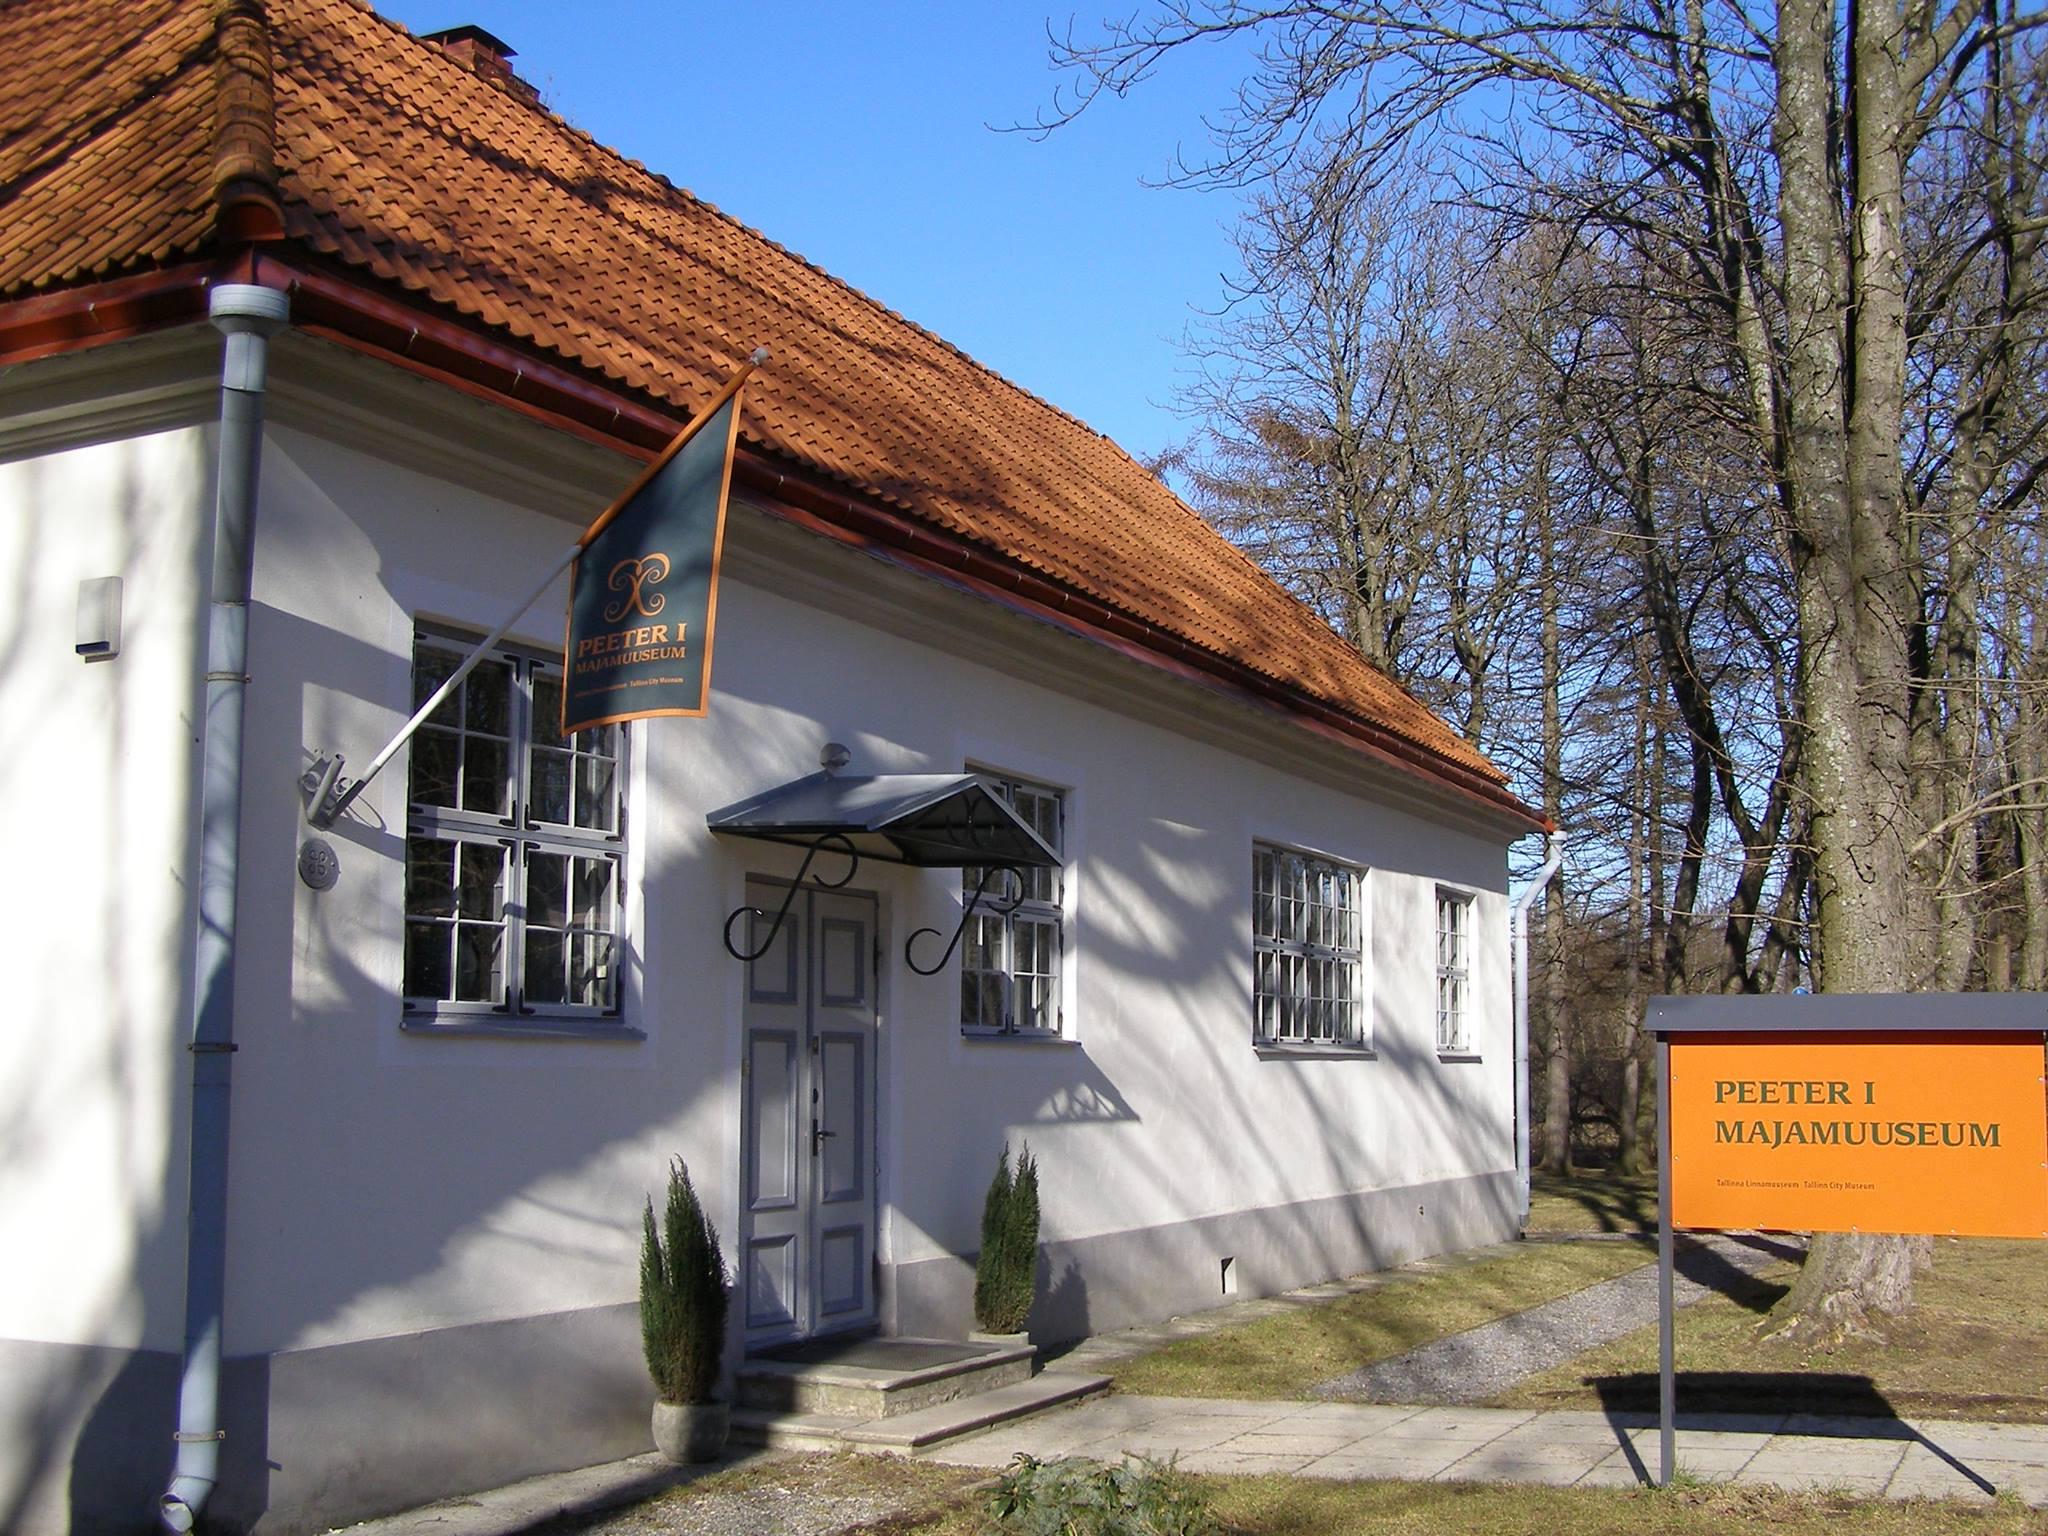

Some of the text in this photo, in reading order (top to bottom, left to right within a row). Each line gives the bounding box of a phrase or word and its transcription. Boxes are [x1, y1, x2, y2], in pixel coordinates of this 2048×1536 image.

[577, 622, 688, 658] PEETER I
[575, 646, 686, 674] MAJAMUUSEUM
[1714, 1080, 1876, 1105] PEETER I
[1714, 1120, 2002, 1149] MAJAMUUSEUM
[1717, 1179, 1875, 1191] Tallinna Linnamuuseum Tallinn City Museum
